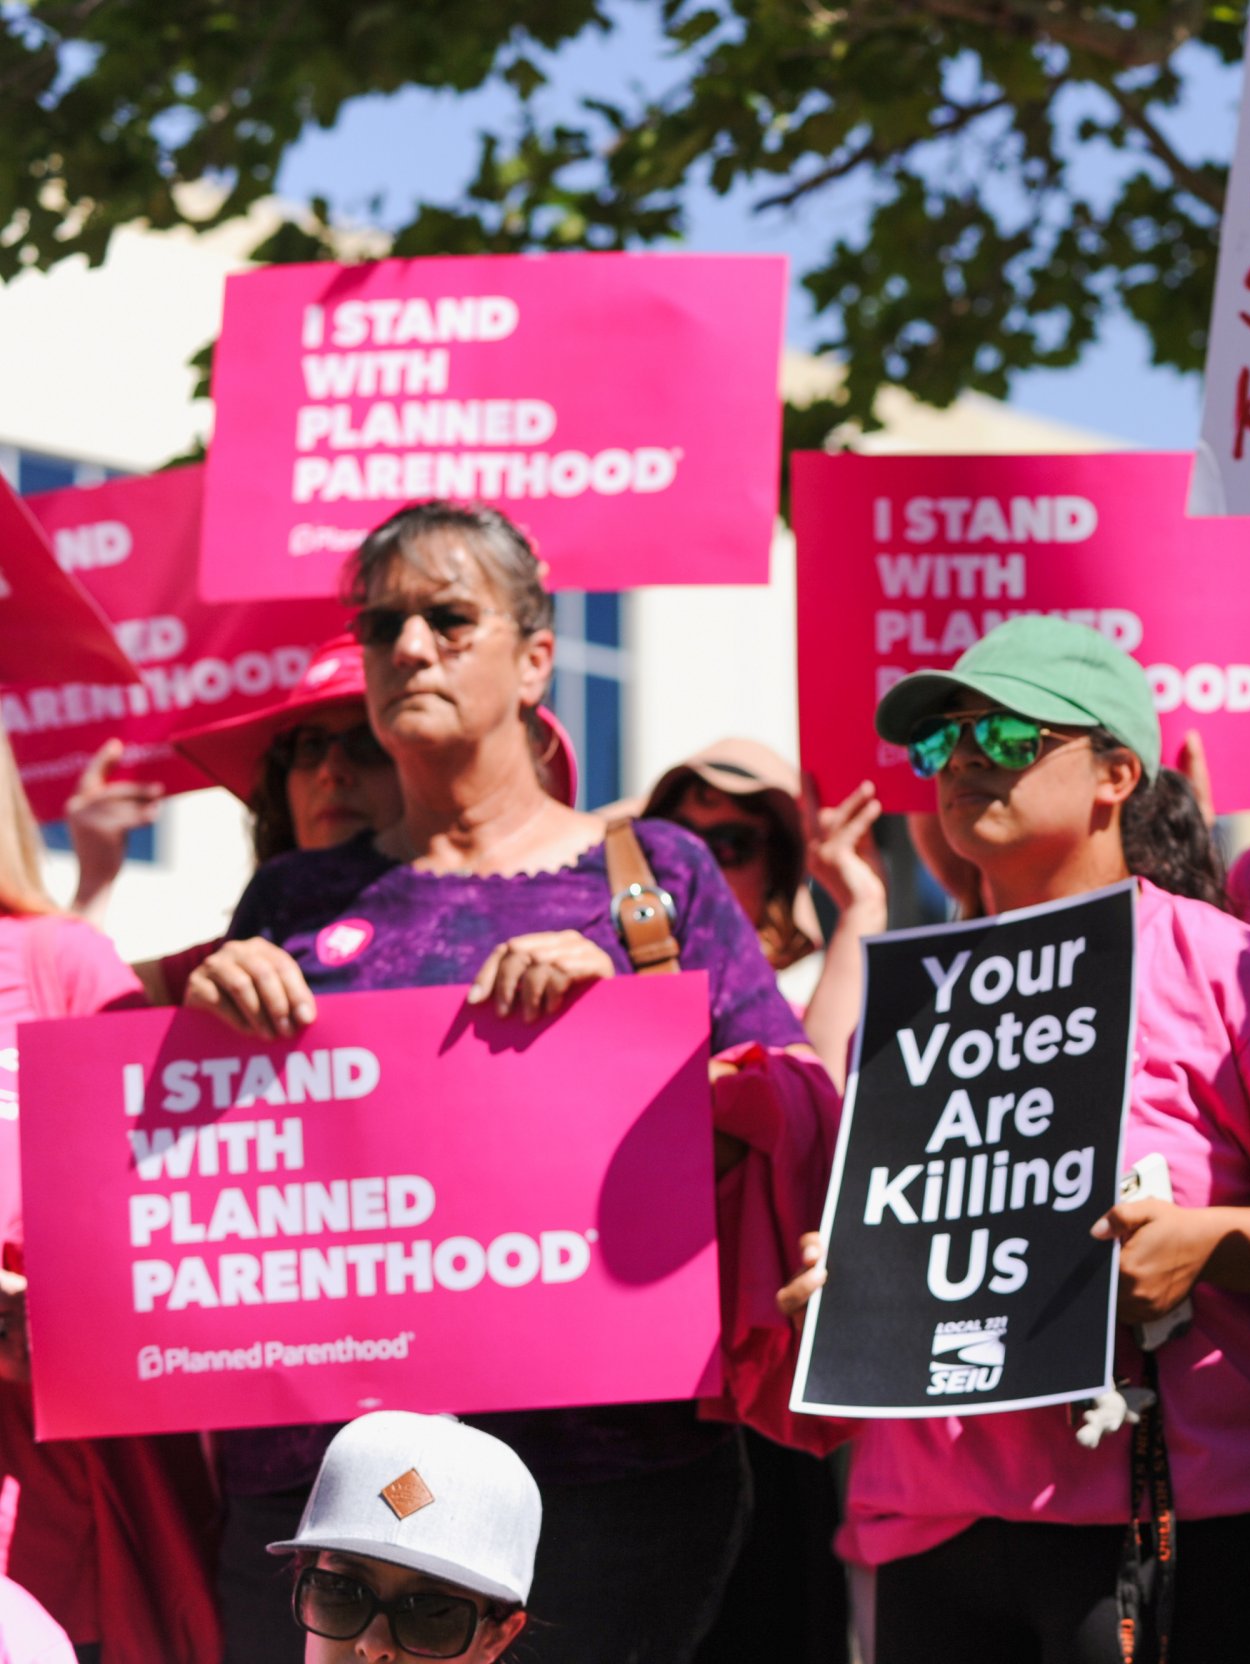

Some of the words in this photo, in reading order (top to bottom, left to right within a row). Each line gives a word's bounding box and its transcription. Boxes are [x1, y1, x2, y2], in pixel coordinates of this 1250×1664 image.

[301, 304, 325, 349] I
[331, 296, 519, 347] STAND
[301, 349, 449, 401] WITH
[296, 400, 556, 452] PLANNED
[292, 447, 678, 503] PARENTHOOD
[873, 497, 891, 542] I
[905, 495, 1099, 543] STAND
[876, 553, 1026, 599] WITH
[922, 936, 1086, 1014] Your
[896, 1006, 1097, 1087] Votes
[122, 1062, 145, 1116] I
[162, 1046, 381, 1113] STAND
[127, 1117, 304, 1182] WITH
[925, 1086, 1055, 1154] Are
[129, 1175, 437, 1248] PLANNED
[863, 1146, 1095, 1226] Killing
[131, 1229, 592, 1313] PARENTHOOD
[926, 1228, 1029, 1302] Us
[164, 1341, 263, 1374] Planned
[265, 1333, 409, 1368] Parenthood
[934, 1318, 982, 1334] LOCAL
[926, 1366, 1003, 1396] SEIU
